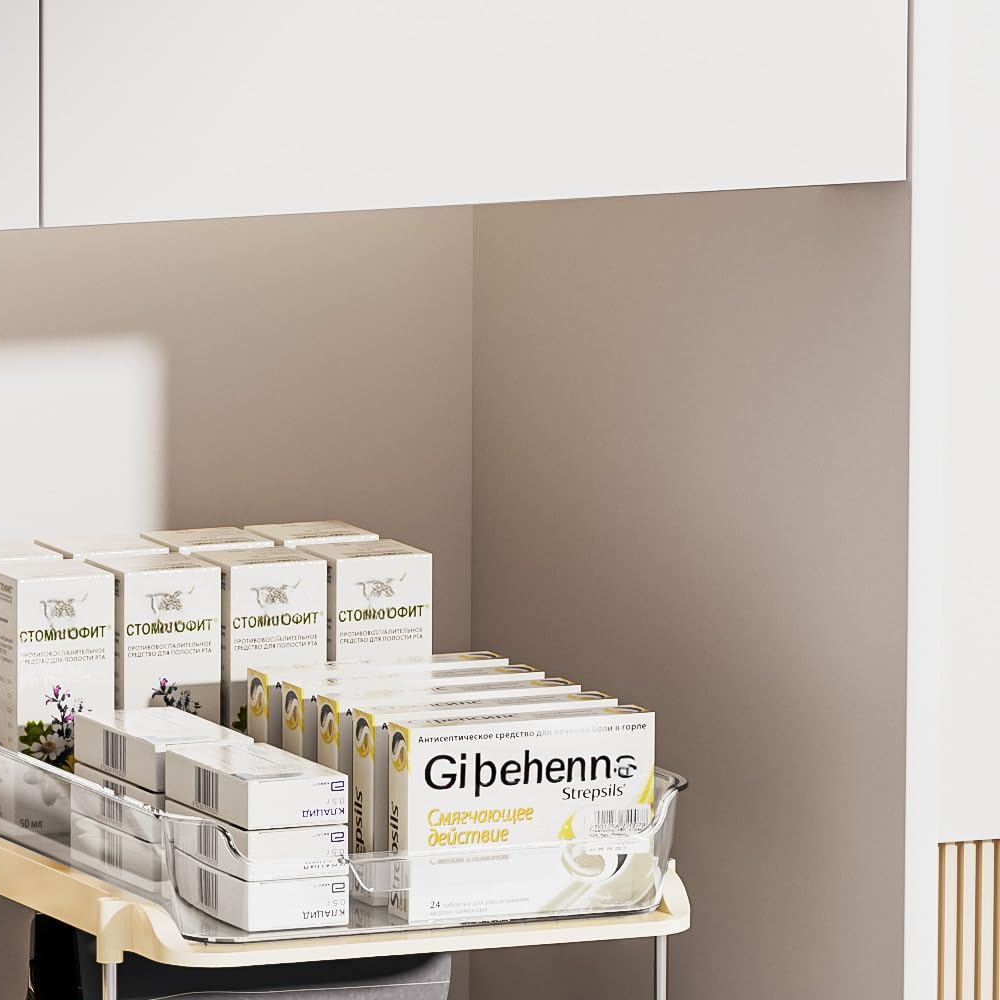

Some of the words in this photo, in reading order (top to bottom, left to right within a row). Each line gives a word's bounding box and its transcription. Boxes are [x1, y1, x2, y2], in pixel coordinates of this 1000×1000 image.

[418, 732, 493, 744] Антисептическое
[562, 784, 623, 801] Strepsils
[19, 817, 31, 829] 50
[427, 806, 534, 827] Смягчающее
[427, 827, 510, 847] действие
[430, 900, 441, 909] 24
